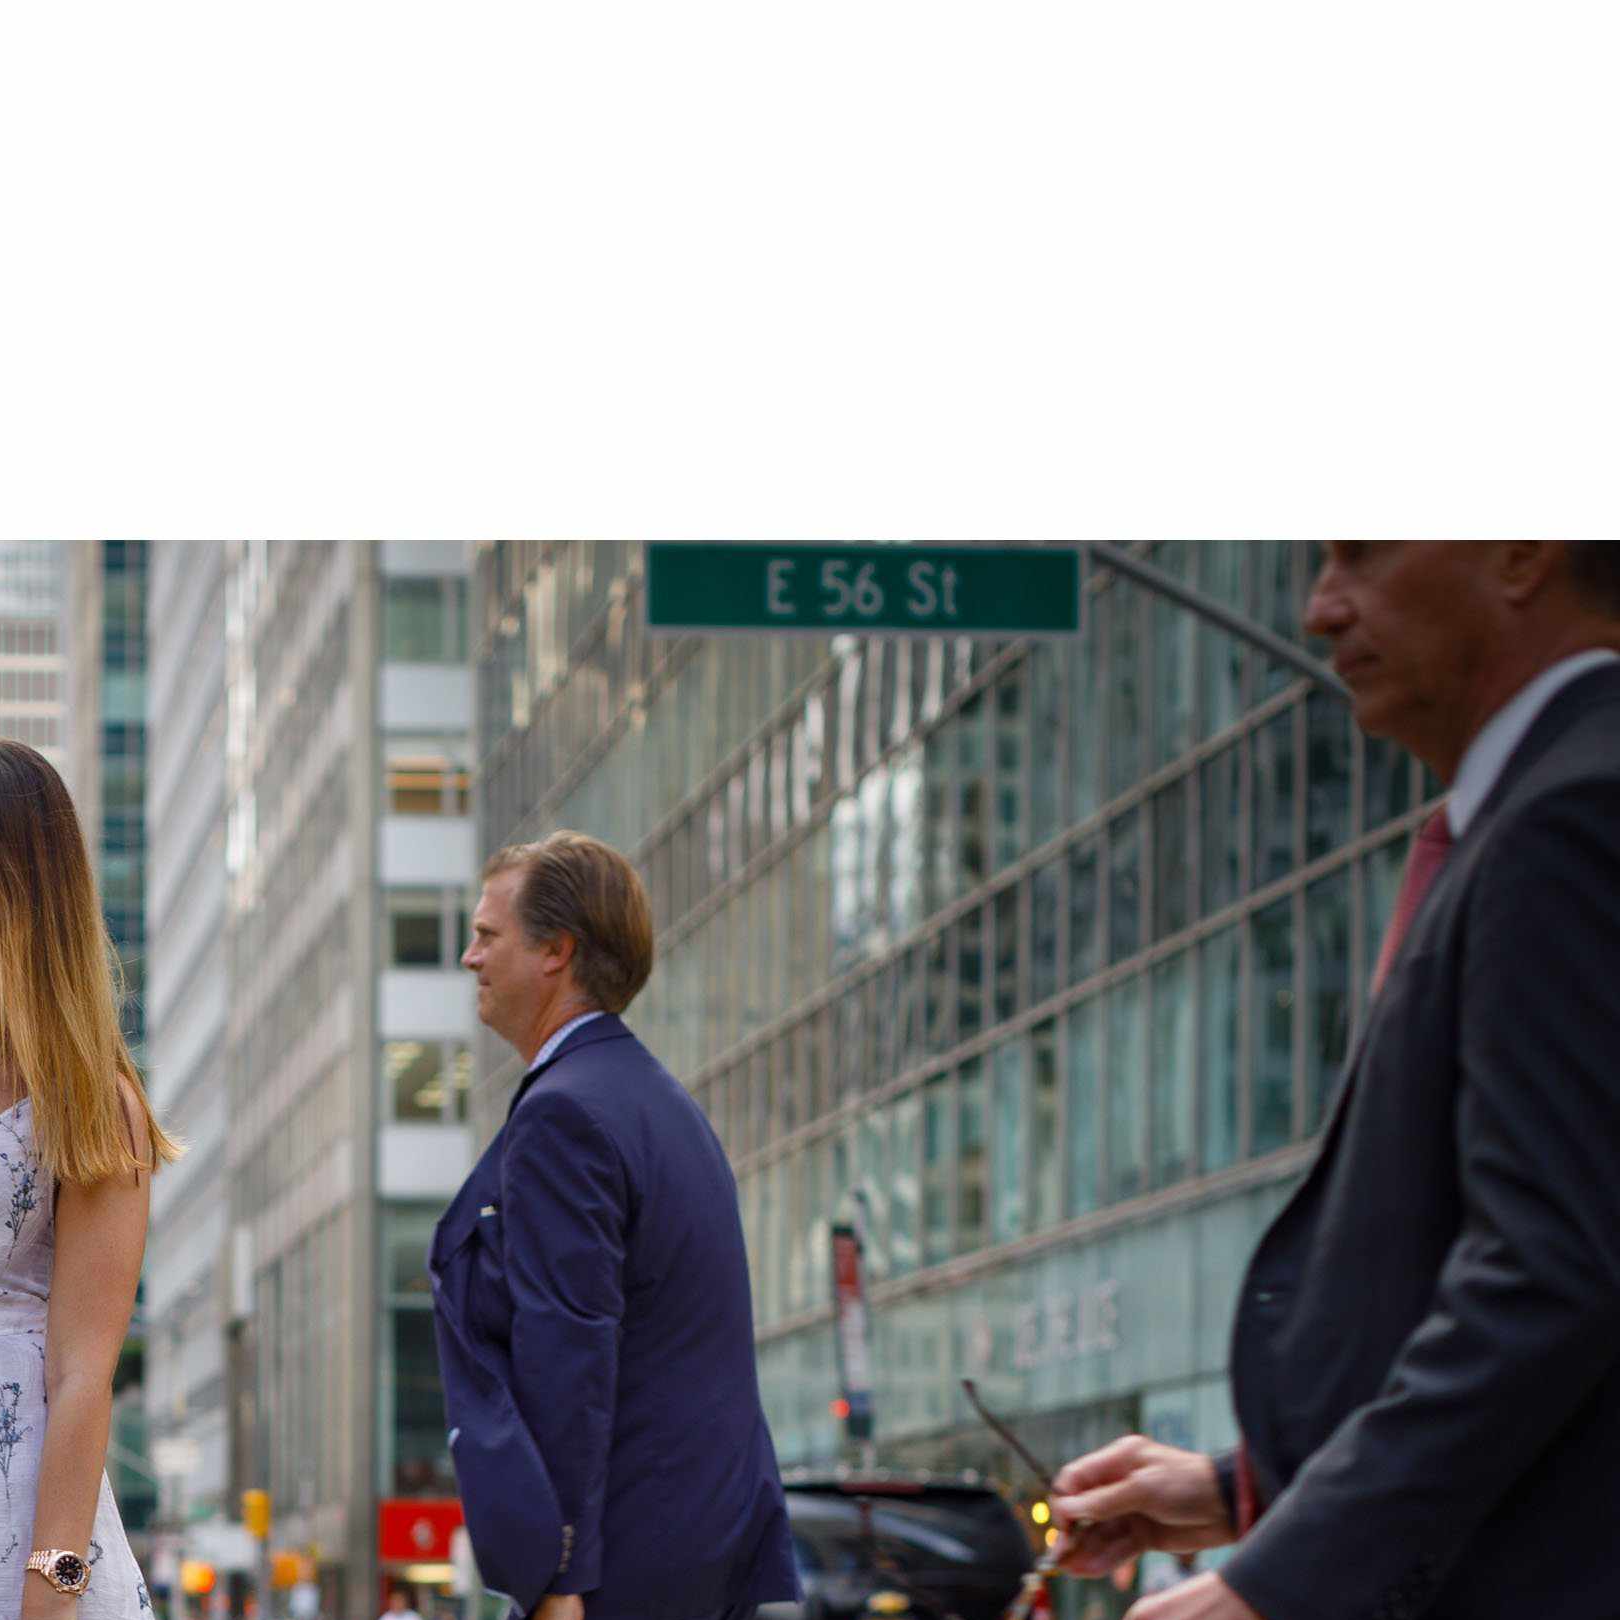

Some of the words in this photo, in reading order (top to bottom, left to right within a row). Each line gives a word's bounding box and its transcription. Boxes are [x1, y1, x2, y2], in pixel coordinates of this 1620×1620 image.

[766, 559, 796, 615] E
[822, 559, 884, 616] 56
[907, 560, 957, 616] St
